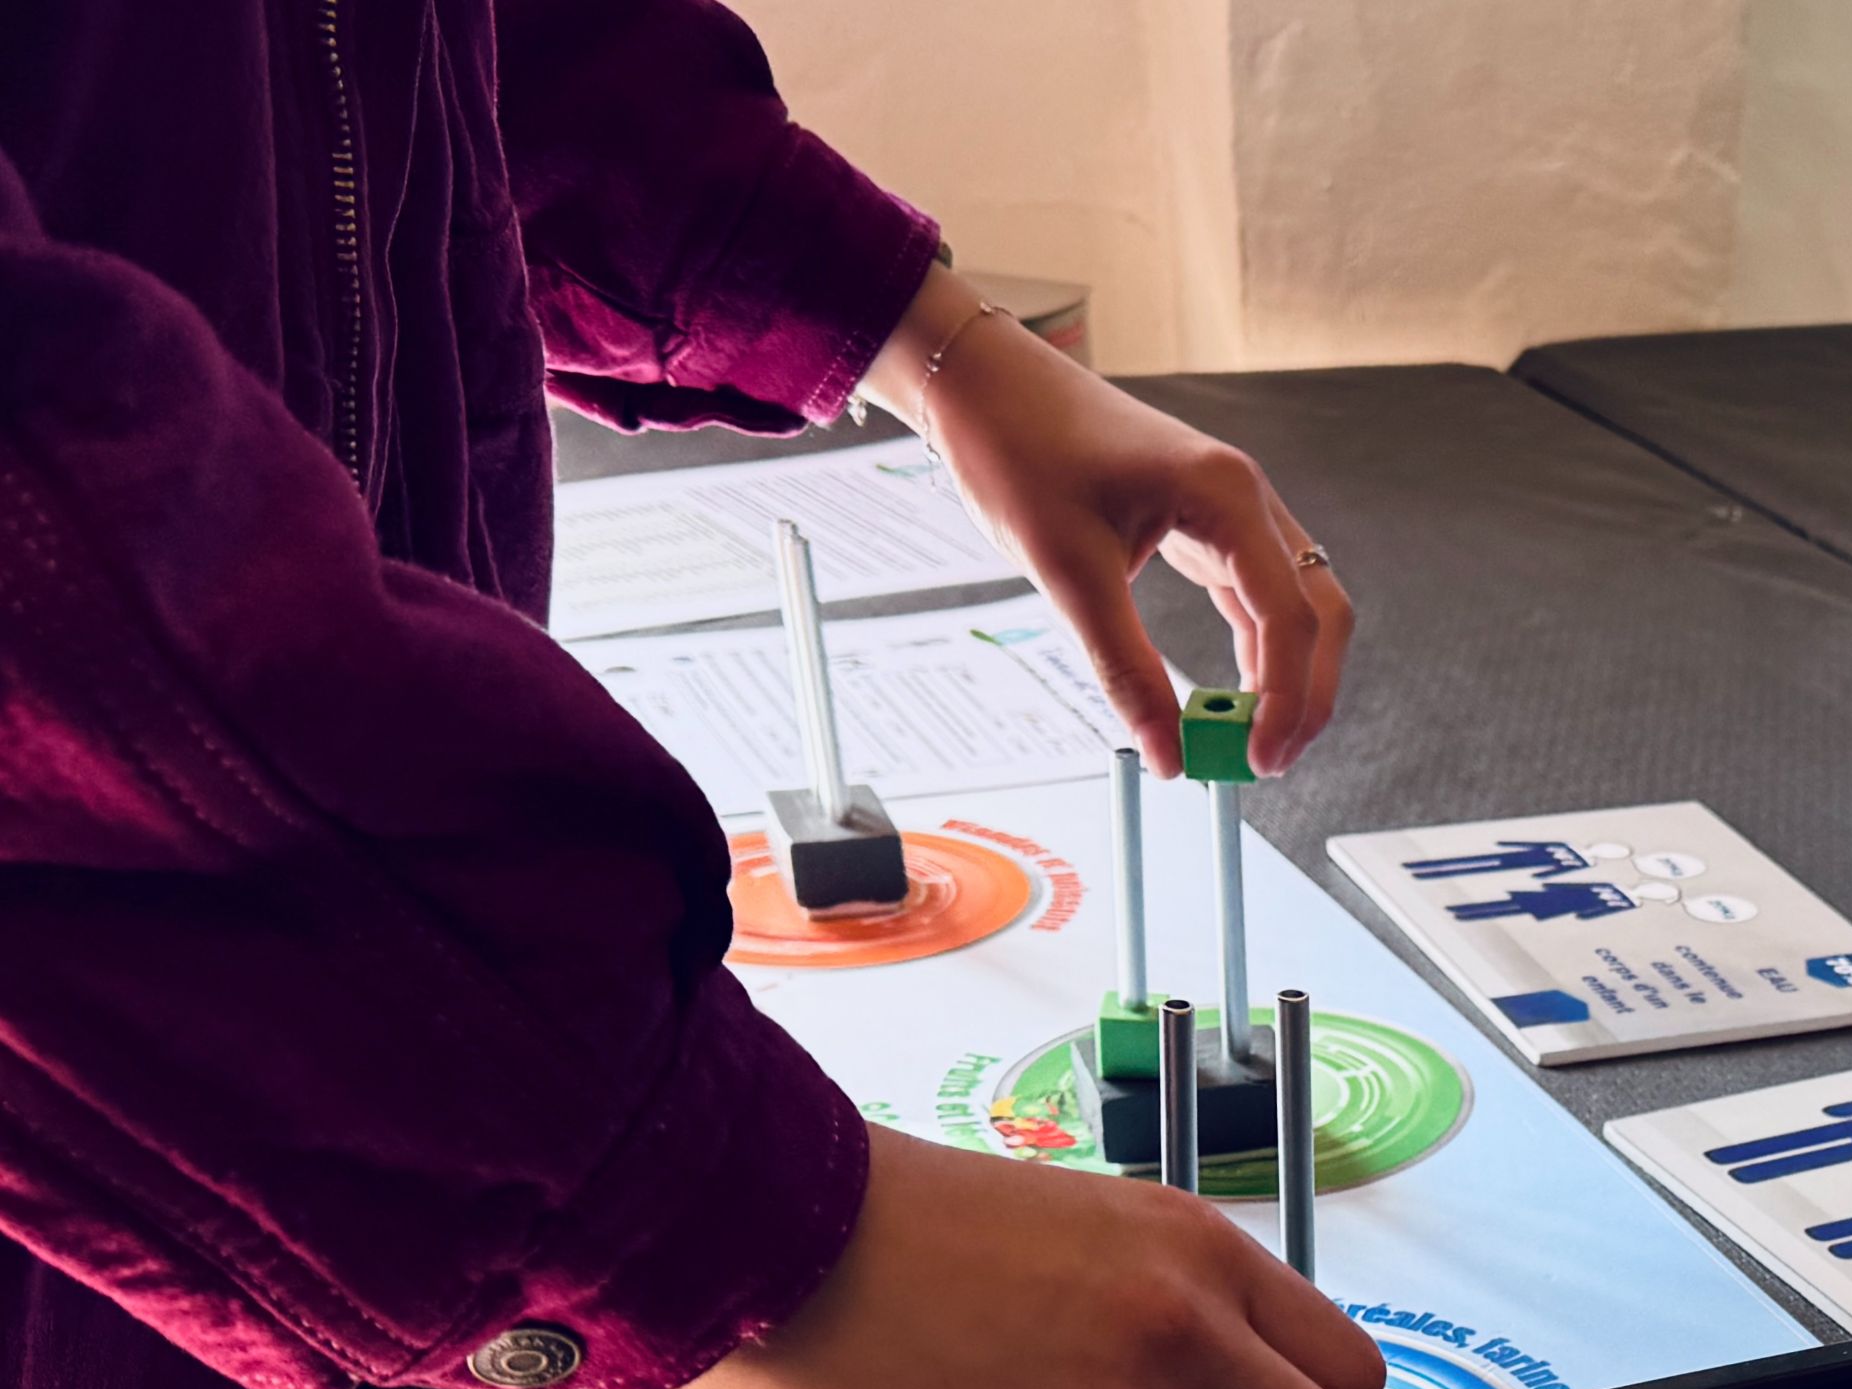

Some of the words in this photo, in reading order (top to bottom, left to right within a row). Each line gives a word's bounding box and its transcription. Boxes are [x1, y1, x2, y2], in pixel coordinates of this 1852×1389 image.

[1595, 947, 1639, 981] corps
[1651, 961, 1691, 990] dans
[1685, 989, 1707, 1005] le
[1675, 945, 1744, 1000] contenue
[1756, 967, 1798, 993] EAU
[1582, 975, 1636, 1014] enfant
[1333, 1299, 1476, 1348] réales,
